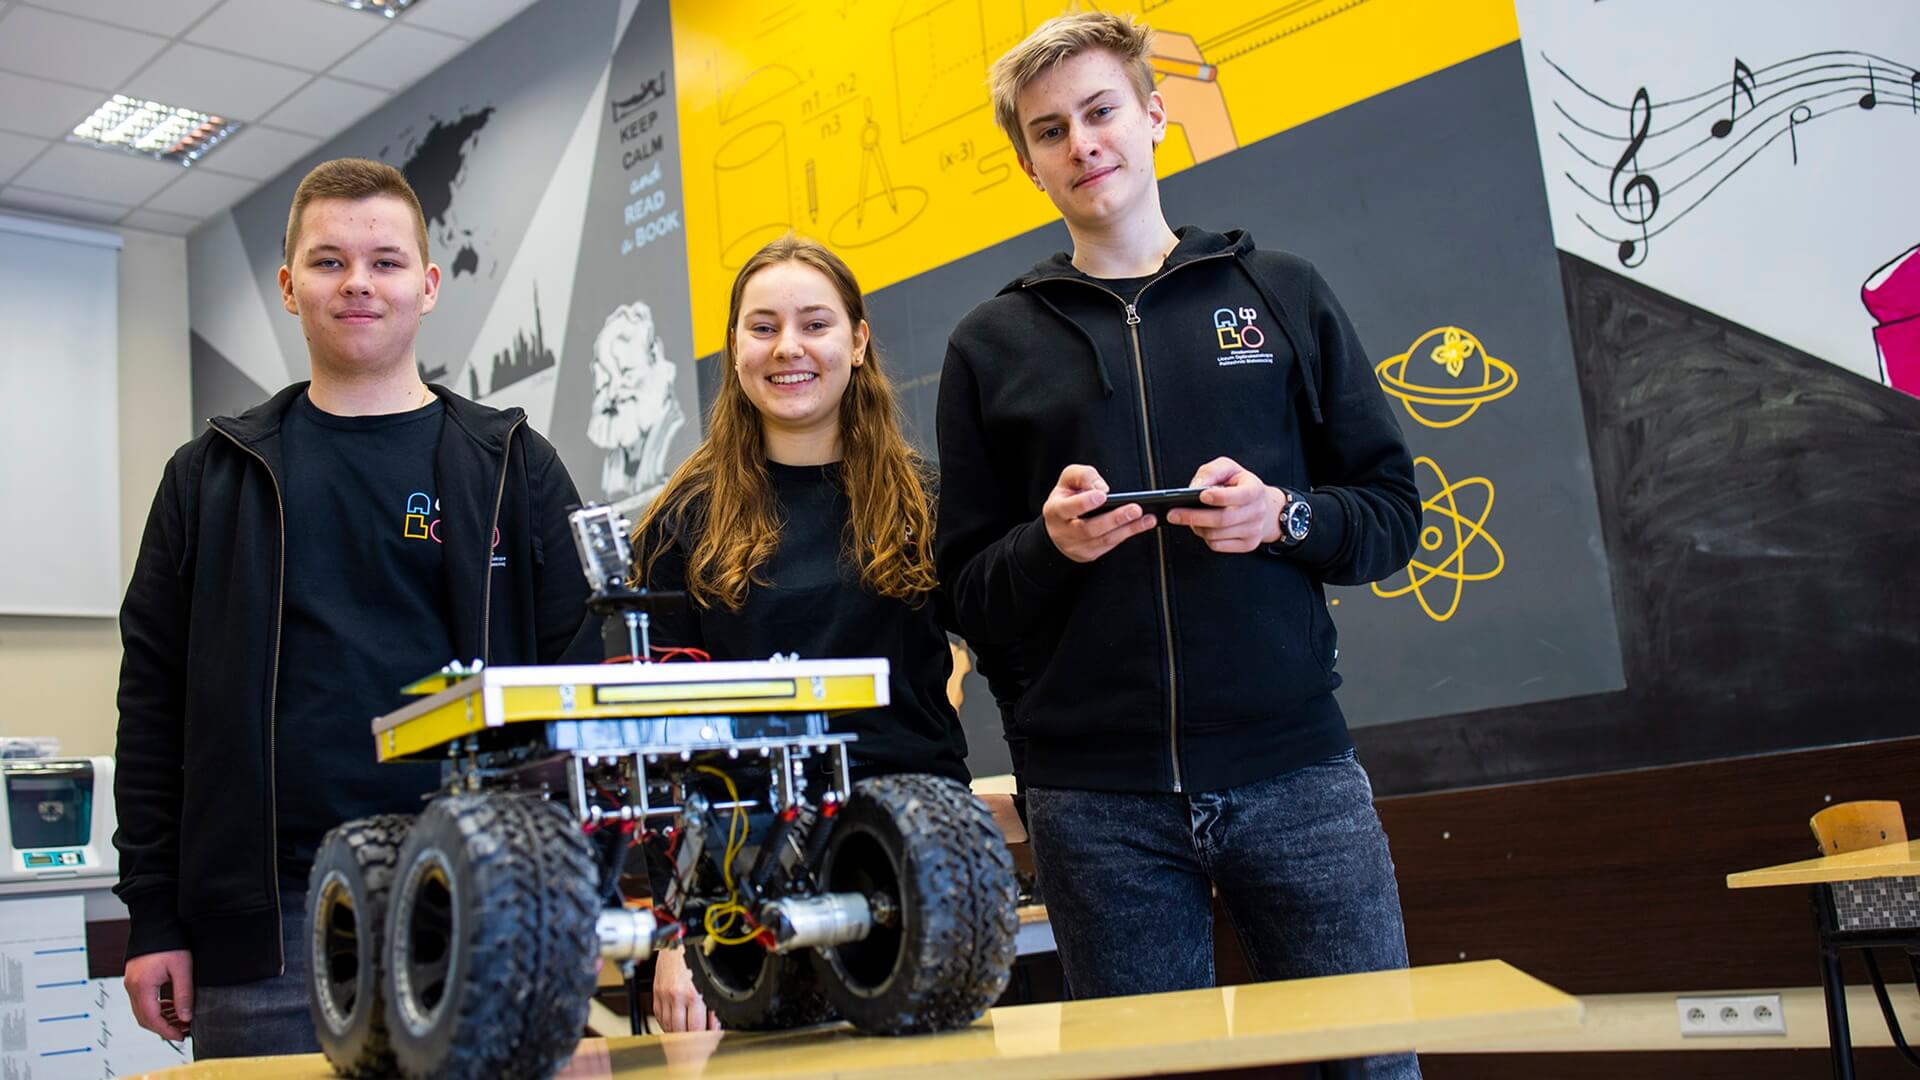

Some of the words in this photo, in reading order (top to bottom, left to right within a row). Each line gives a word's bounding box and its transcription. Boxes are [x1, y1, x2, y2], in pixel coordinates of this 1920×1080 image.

[620, 111, 658, 144] KEEP
[622, 134, 664, 170] CALM
[624, 189, 666, 224] READ
[635, 209, 680, 247] BOOK
